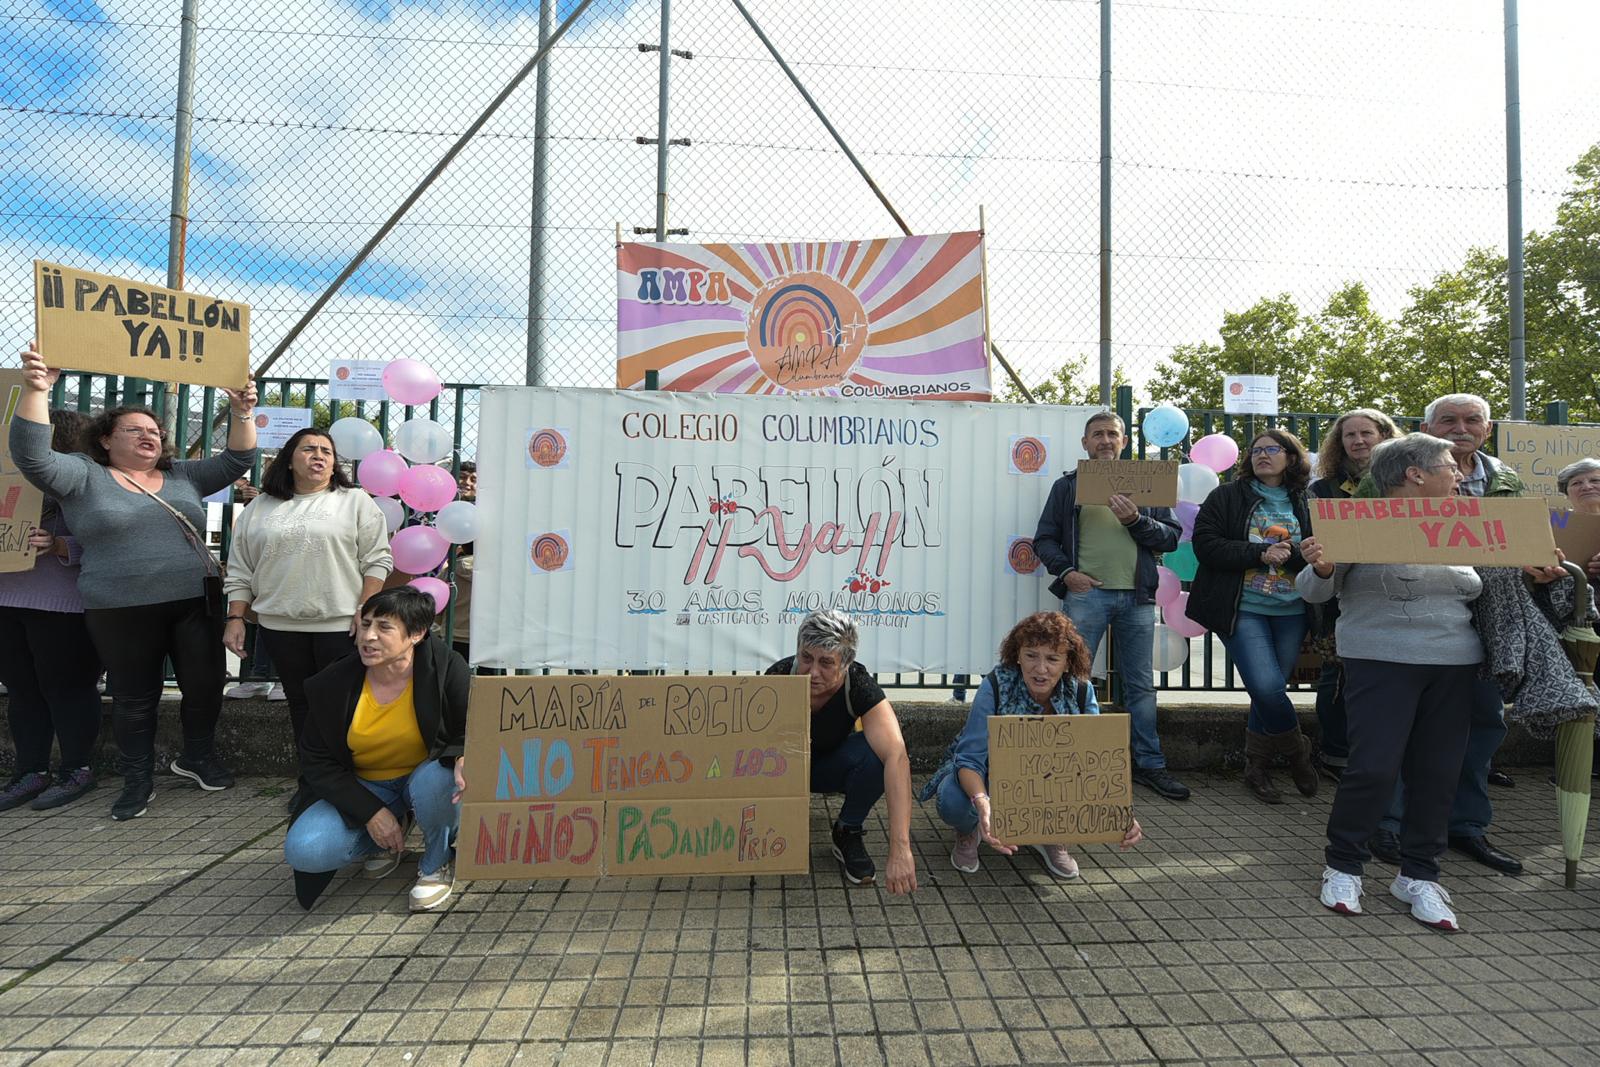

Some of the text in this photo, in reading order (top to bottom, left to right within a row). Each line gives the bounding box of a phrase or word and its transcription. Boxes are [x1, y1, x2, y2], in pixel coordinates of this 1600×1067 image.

[636, 270, 731, 302] AMPA
[122, 319, 205, 363] YA!!
[841, 382, 971, 397] COLUMBRIANOS
[622, 412, 939, 447] COLEGIO COLUMBRIANOS
[615, 455, 944, 548] PABELLÓN
[1418, 520, 1507, 551] YA!!
[627, 589, 667, 612] 30
[682, 585, 763, 612] AÑOS
[698, 612, 769, 625] CASTIGADOS
[778, 613, 797, 625] POR
[500, 677, 778, 737] MARÍA DEL ROCÍO
[496, 737, 787, 801] NO TENGAS A LOS
[1020, 748, 1127, 776] MOJADOS
[616, 805, 736, 864] PASANDO
[738, 804, 787, 862] FRÍO
